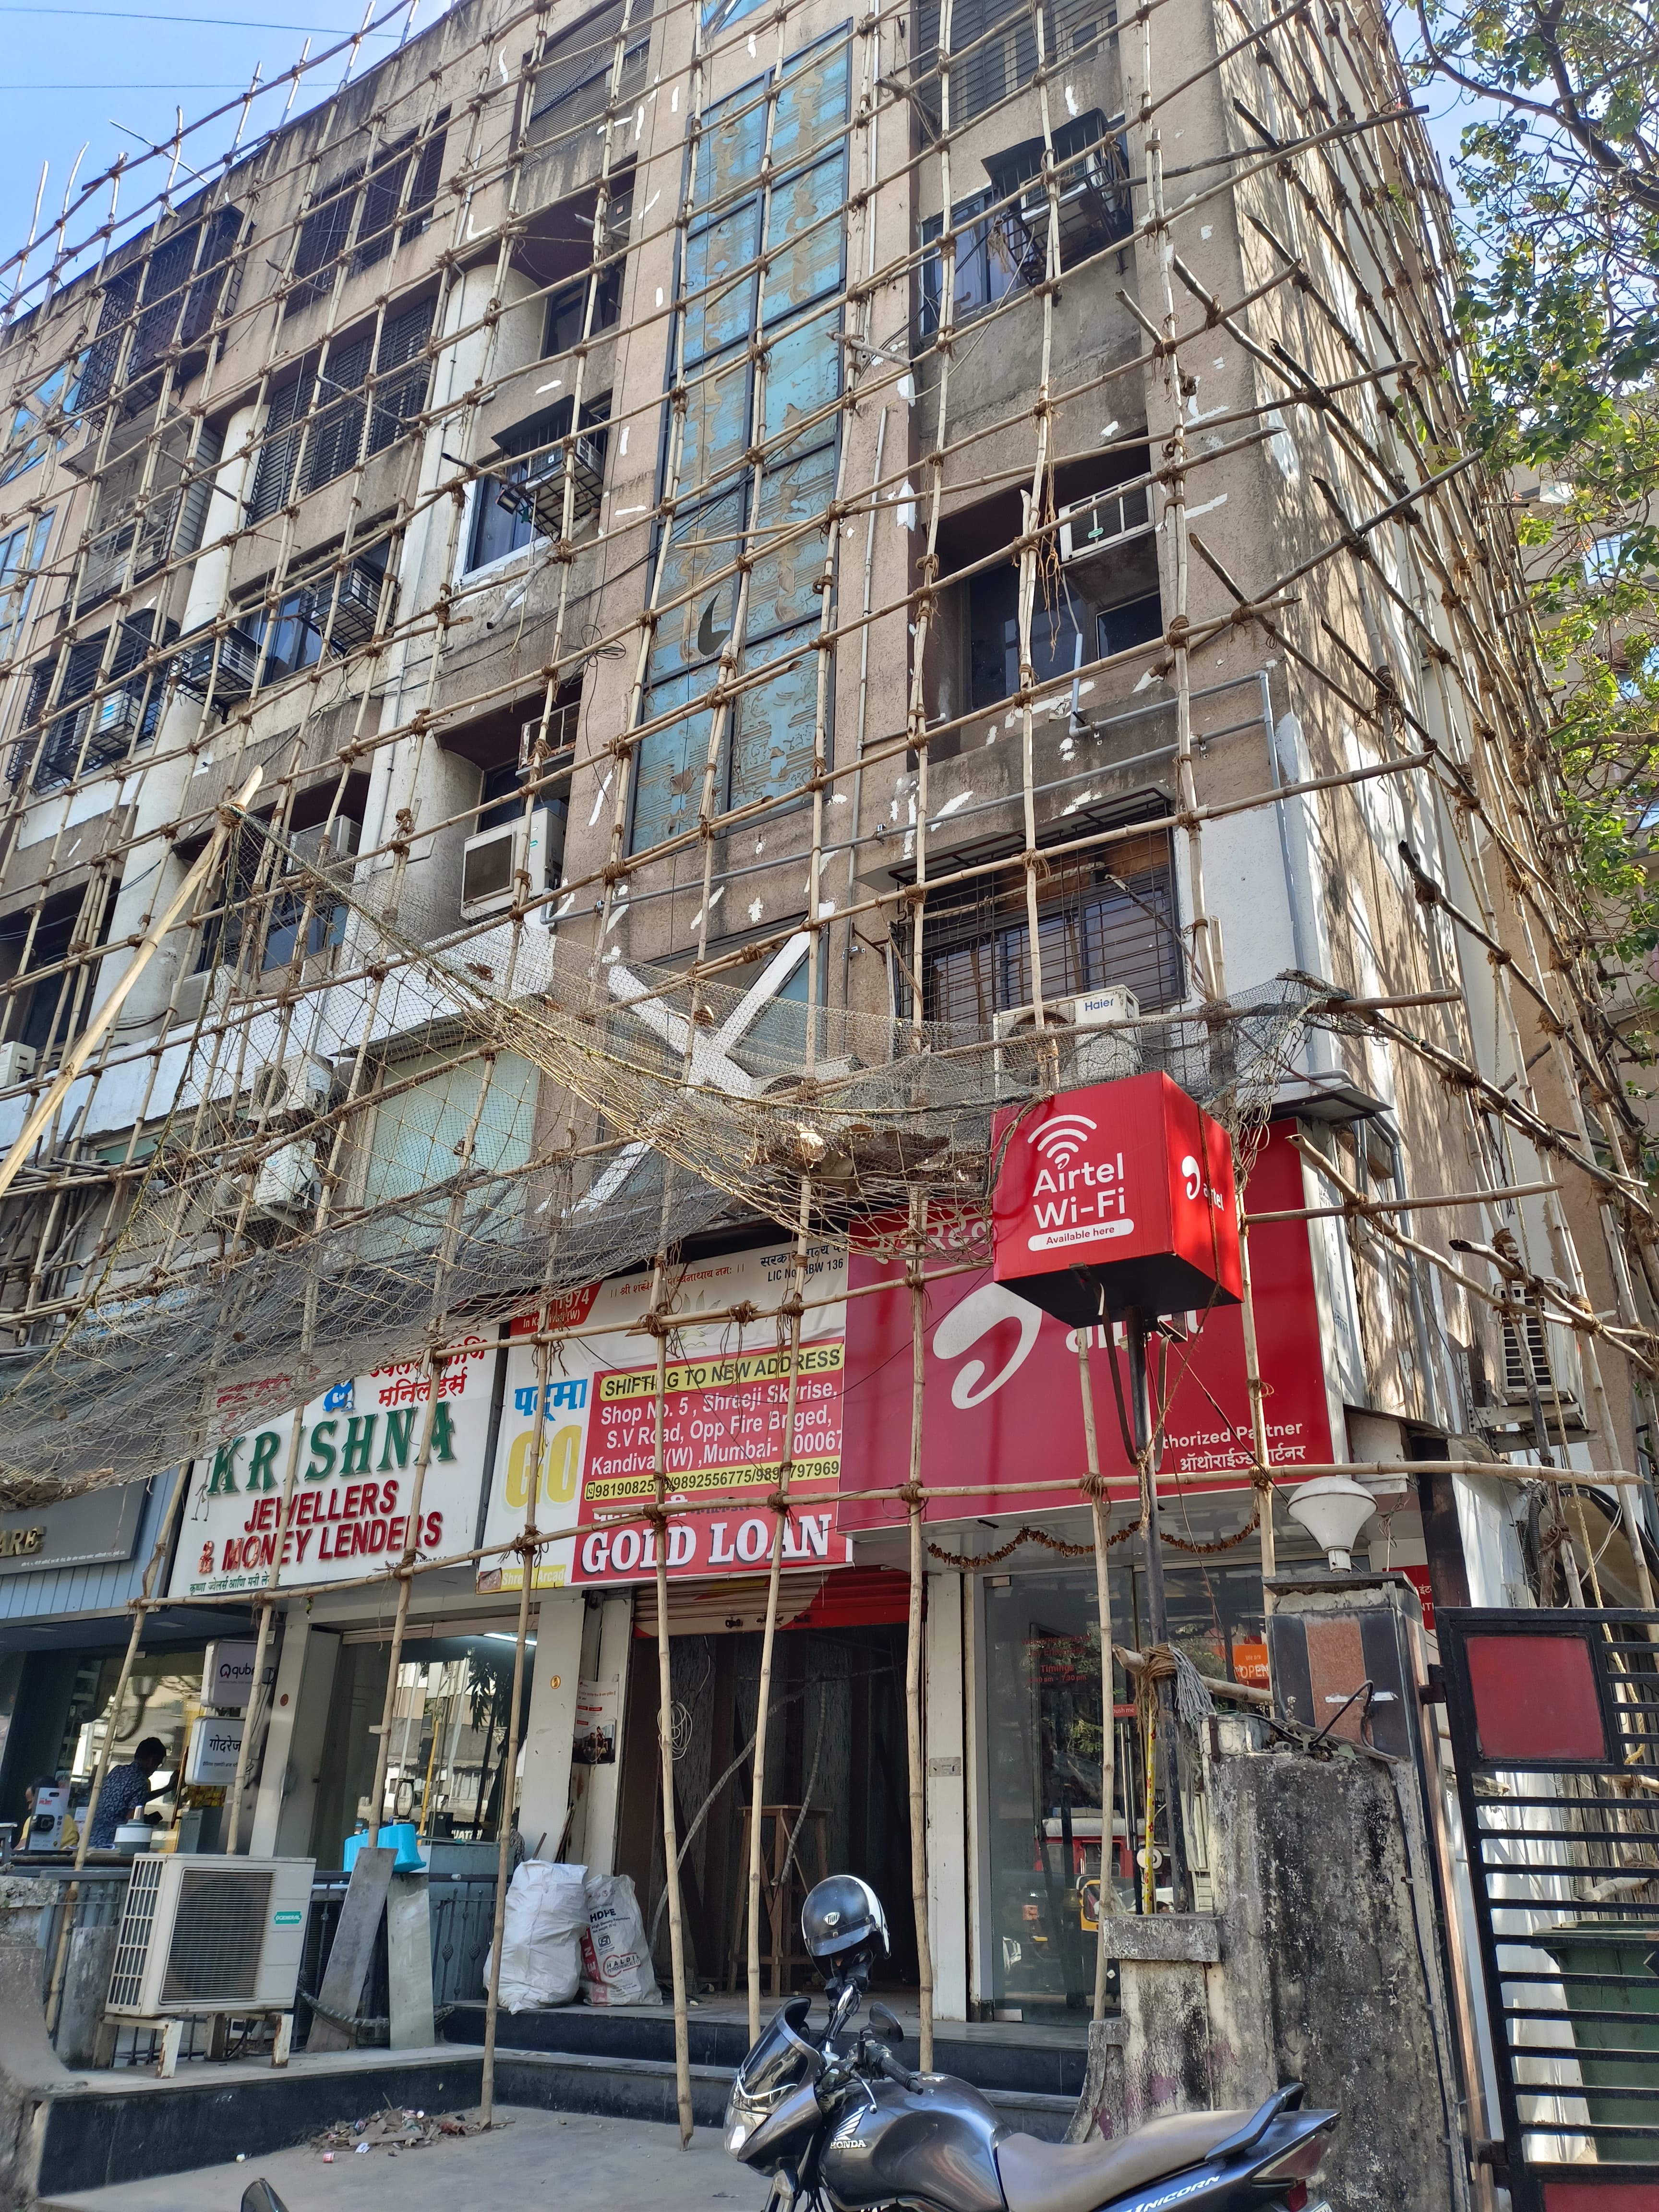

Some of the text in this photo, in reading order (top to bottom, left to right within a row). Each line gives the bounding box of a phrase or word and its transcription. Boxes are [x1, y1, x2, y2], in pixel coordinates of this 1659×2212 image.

[1085, 998, 1114, 1011] Haier
[1033, 1152, 1124, 1197] Airtel
[1034, 1187, 1125, 1229] Wi-Fi
[1046, 1227, 1115, 1245] Available here
[768, 1270, 781, 1282] LIC
[827, 1258, 843, 1270] 136
[523, 1319, 530, 1328] In
[605, 1349, 840, 1397] SHIFTIG TO NEW ADDRESS
[601, 1406, 642, 1426] Shop
[679, 1397, 688, 1416] 5
[702, 1386, 762, 1413] Shreeji
[767, 1380, 837, 1404] Skrise,
[607, 1428, 635, 1449] S.V
[690, 1419, 725, 1443] Opp
[730, 1414, 763, 1435] Fire
[769, 1405, 832, 1432] Brged,
[1162, 1423, 1303, 1450] thorized Patner
[207, 1402, 457, 1496] KRSHNA
[591, 1446, 694, 1476] Kandivai(W)
[784, 1429, 842, 1455] 00067
[198, 1511, 443, 1574] & MONEY LENDERS
[582, 1514, 832, 1574] GOLD LOAN
[229, 1575, 246, 1588] आणि
[1040, 1665, 1075, 1674] Timings
[1240, 1664, 1269, 1679] OPEN
[209, 1734, 242, 1753] गोदरेज
[589, 1908, 616, 1923] HDPE
[830, 2140, 867, 2150] HONDA
